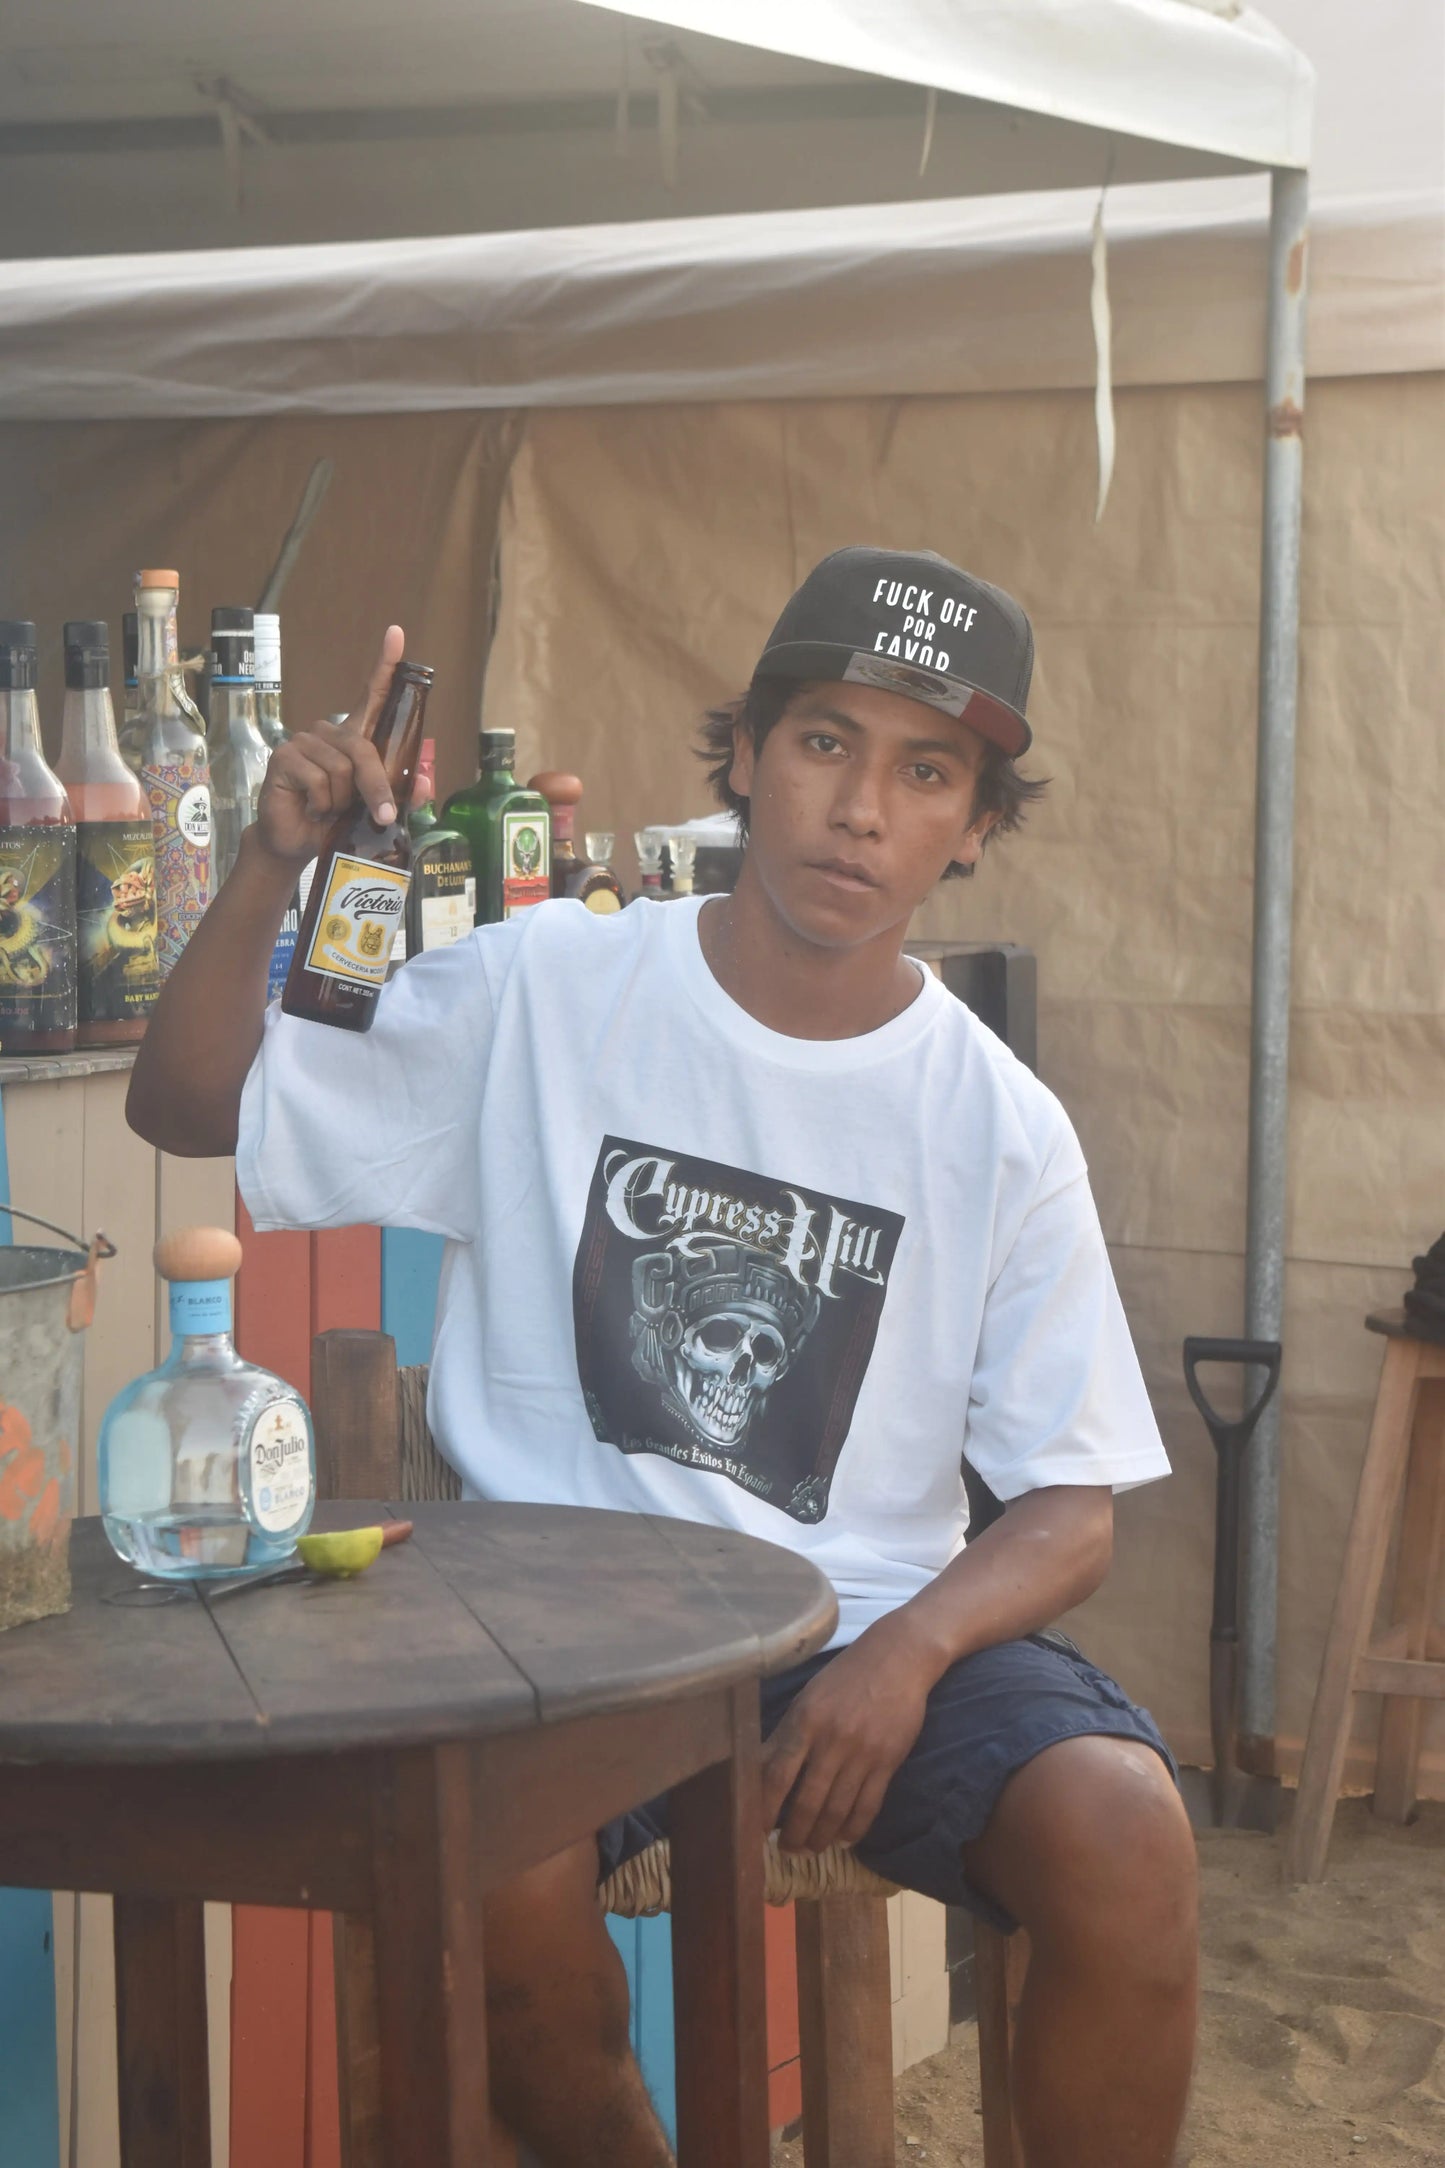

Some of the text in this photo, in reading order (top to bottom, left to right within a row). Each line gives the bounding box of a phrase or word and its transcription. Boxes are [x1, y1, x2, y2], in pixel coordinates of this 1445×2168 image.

[873, 579, 978, 632] FUCK OFF
[903, 615, 936, 641] POR
[331, 951, 369, 973] CERVECERIA
[603, 1149, 885, 1299] Cypress Hill
[645, 1437, 689, 1461] Grandes
[691, 1443, 723, 1469] Éxitos
[724, 1457, 738, 1476] En
[738, 1463, 774, 1495] Español
